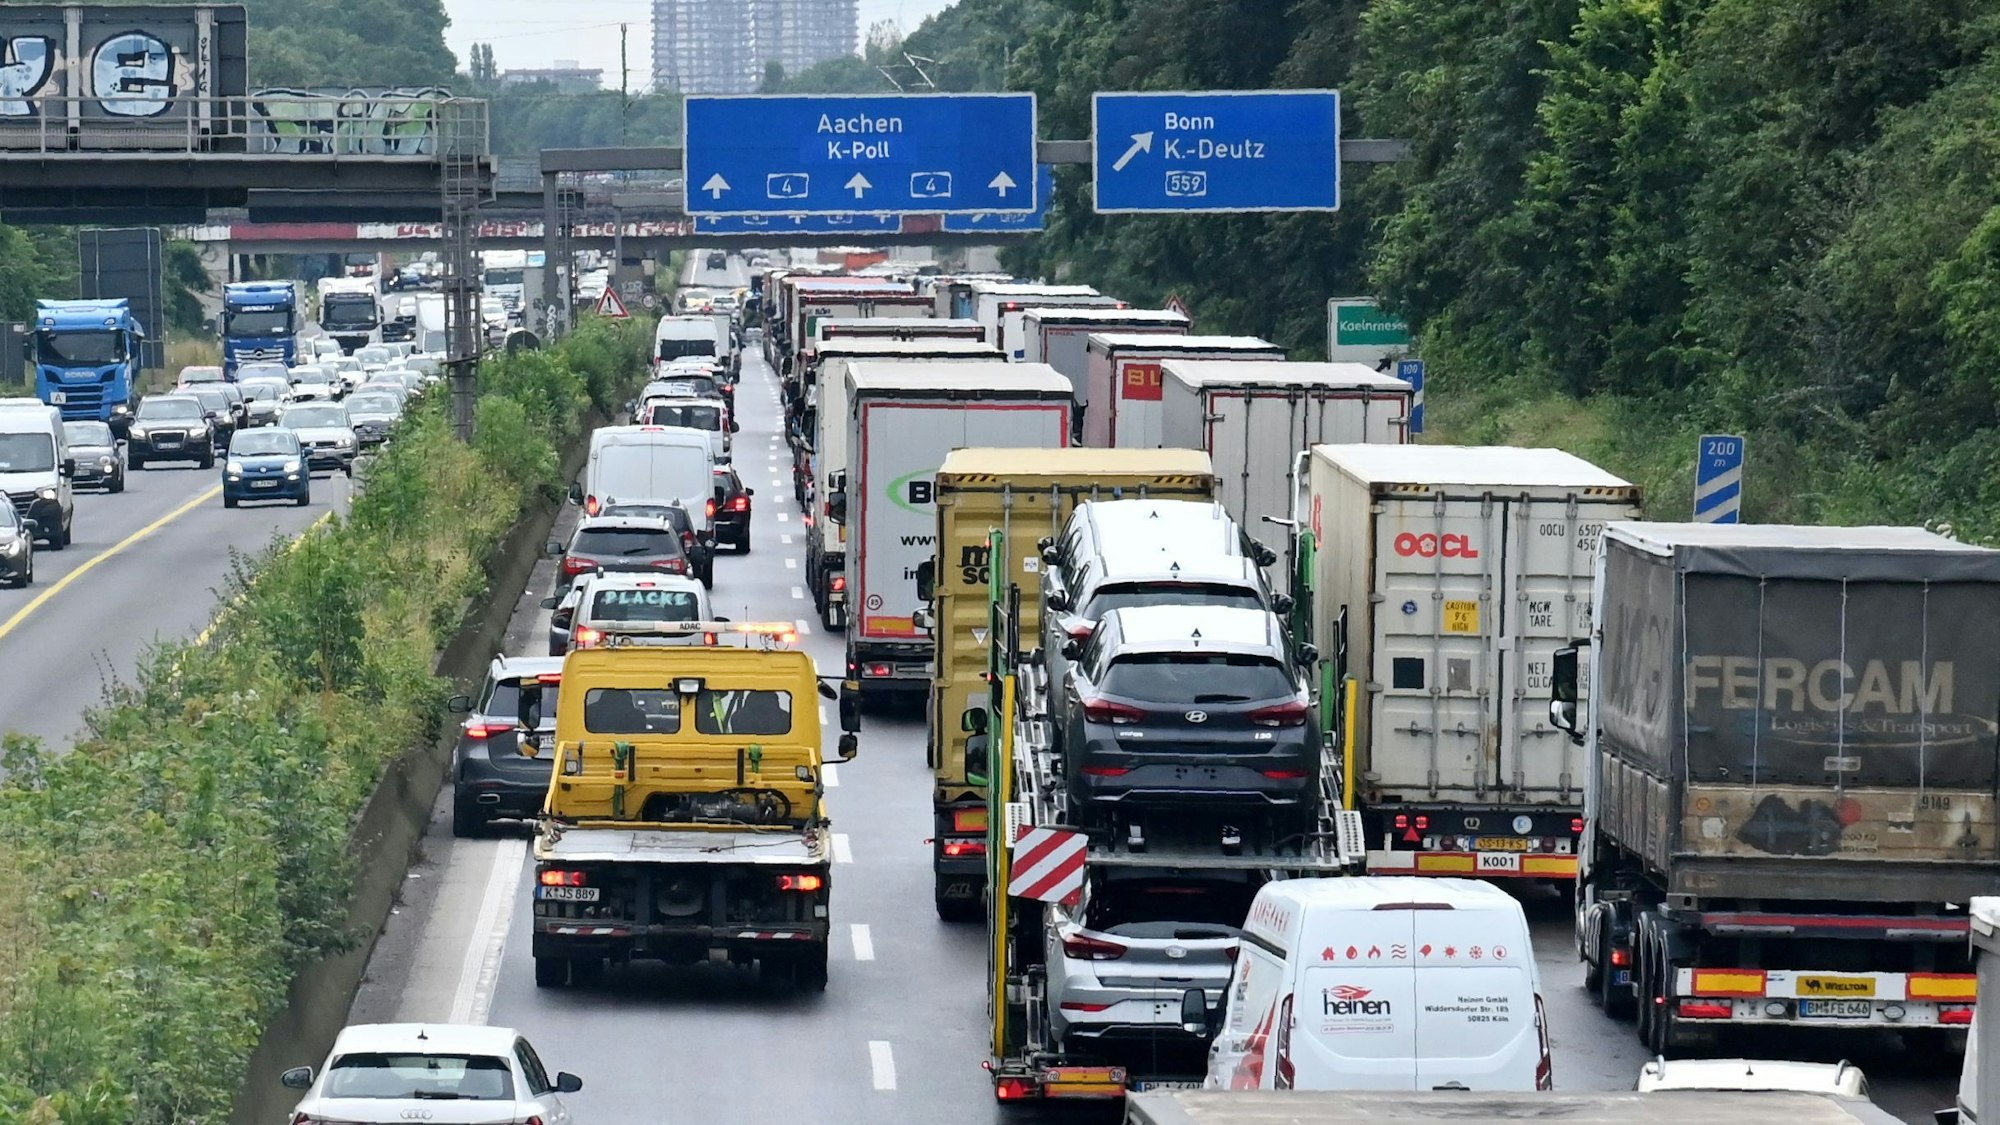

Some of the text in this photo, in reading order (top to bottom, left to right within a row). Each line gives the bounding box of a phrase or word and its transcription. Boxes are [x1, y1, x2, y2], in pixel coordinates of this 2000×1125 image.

[817, 113, 903, 133] Aachen
[1165, 112, 1214, 130] Bonn
[828, 140, 890, 159] K-Poll
[1165, 138, 1265, 159] K.-Deutz
[782, 178, 792, 193] 4
[926, 177, 936, 192] 4
[1171, 175, 1201, 192] 559
[1707, 442, 1735, 455] 200
[1713, 459, 1726, 467] m
[1394, 532, 1478, 558] OOCL
[679, 623, 701, 631] ADAC
[1684, 655, 1954, 713] FERCAM
[1483, 857, 1514, 867] K001
[545, 888, 553, 898] K
[575, 889, 595, 899] 889
[1825, 982, 1868, 991] WIELTON
[1323, 989, 1390, 1015] heinen
